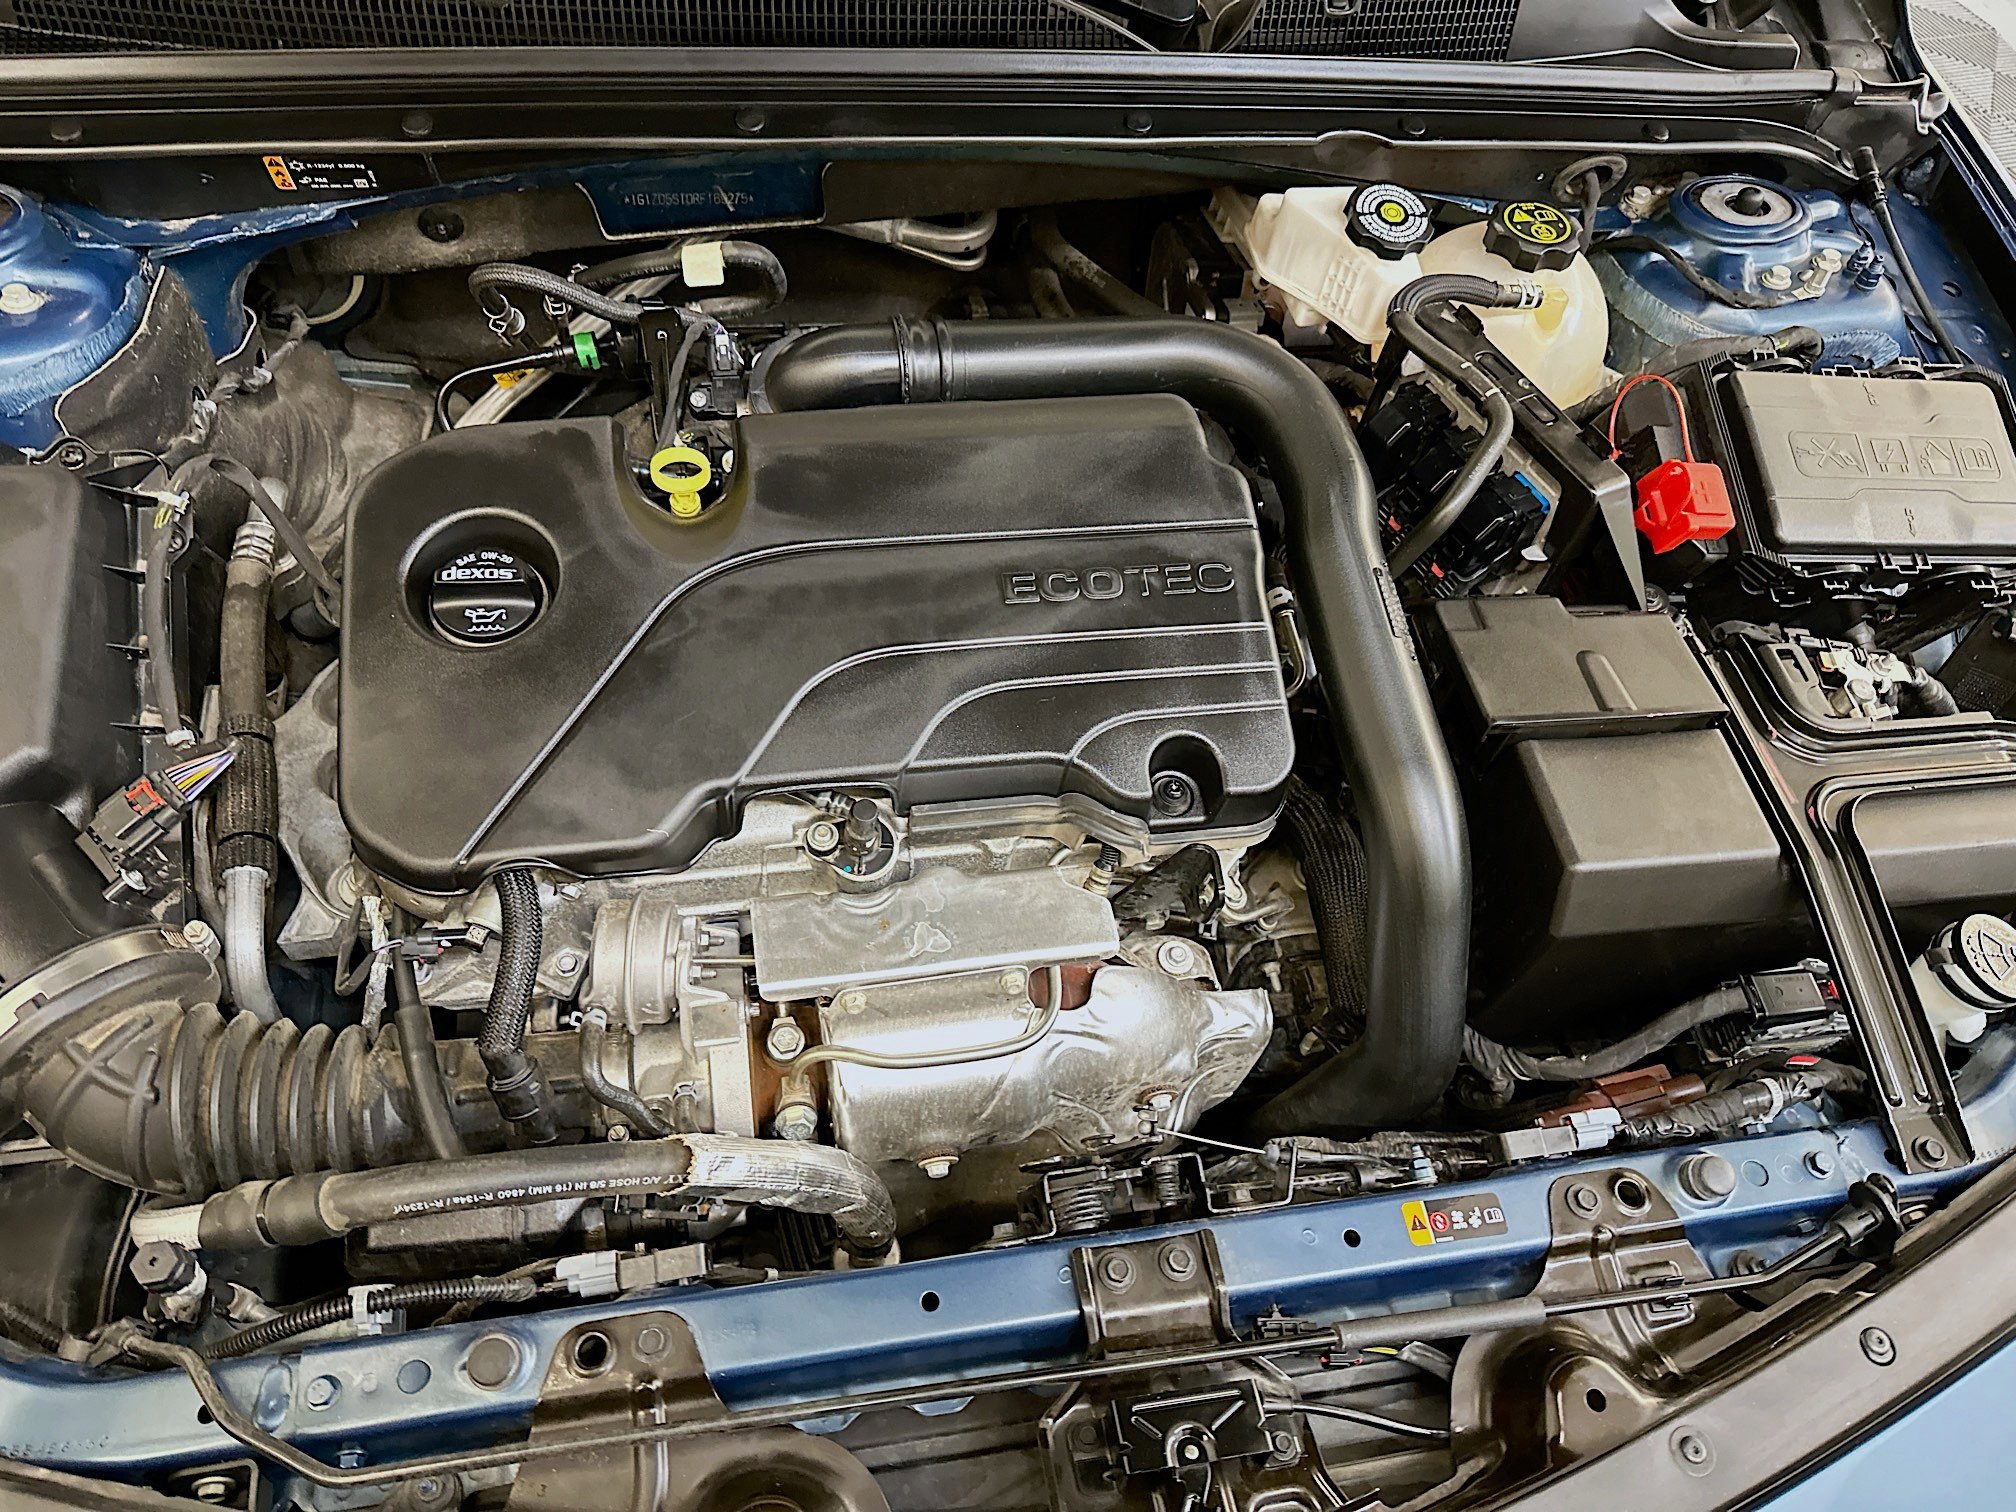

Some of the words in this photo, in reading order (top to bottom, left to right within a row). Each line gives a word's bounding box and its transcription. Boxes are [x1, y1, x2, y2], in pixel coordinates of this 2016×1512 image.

[455, 553, 477, 566] SAE
[480, 551, 514, 564] 0W-20
[441, 565, 517, 581] dexos
[1001, 561, 1235, 604] ECOTEC
[574, 1181, 587, 1191] IN
[608, 1177, 640, 1188] HOSE
